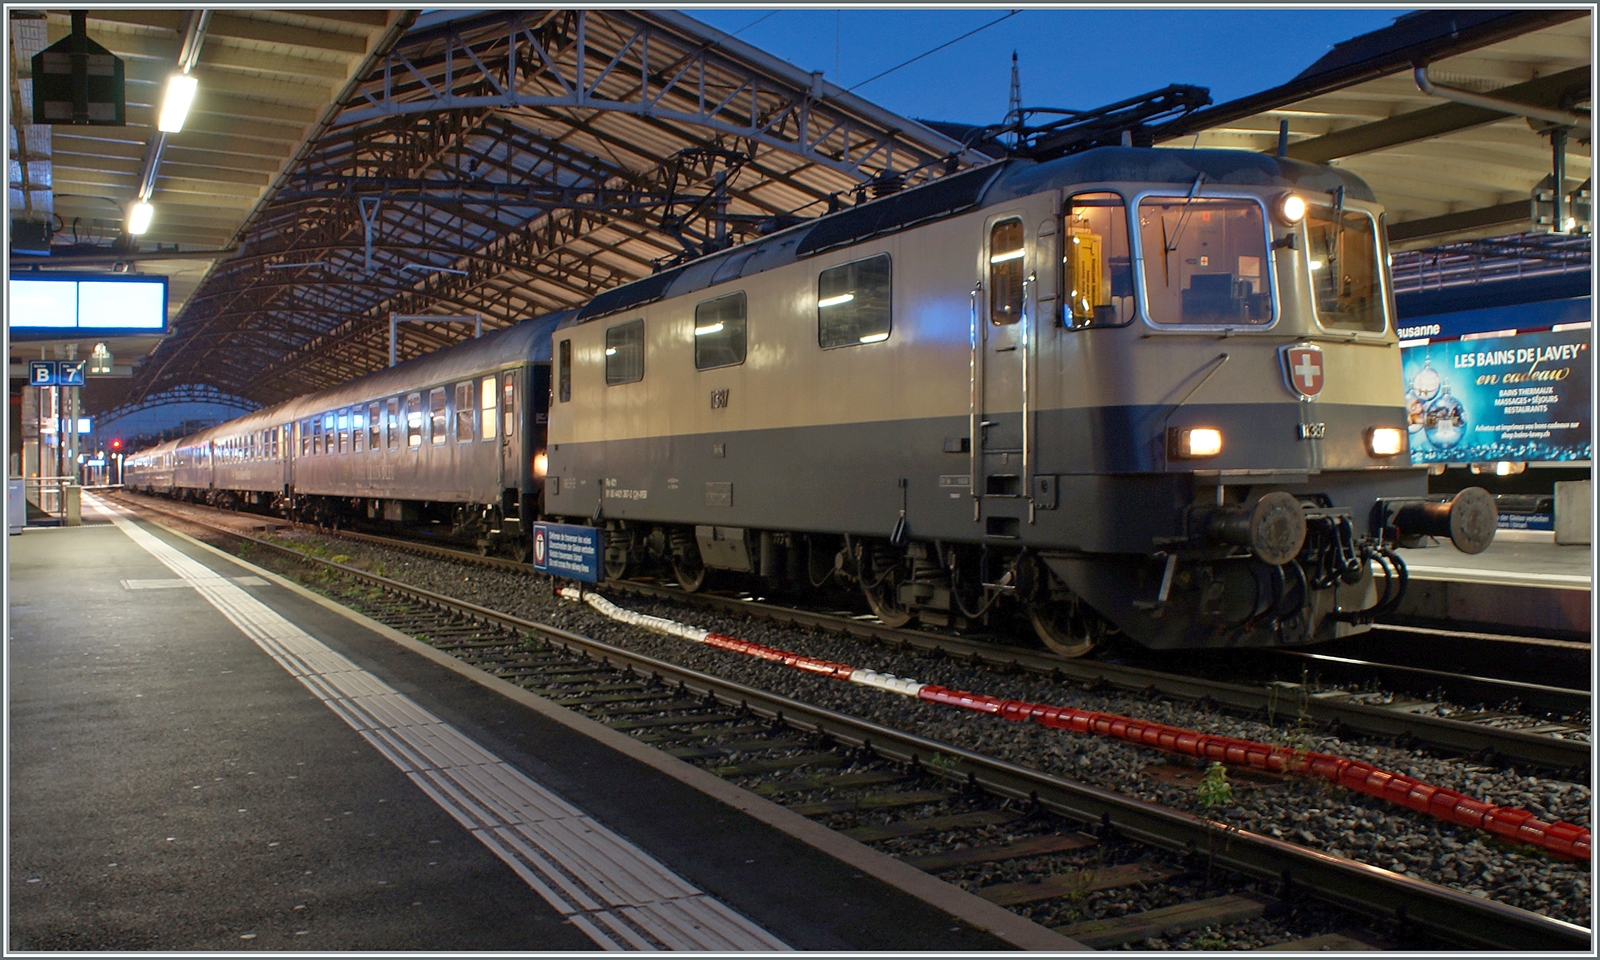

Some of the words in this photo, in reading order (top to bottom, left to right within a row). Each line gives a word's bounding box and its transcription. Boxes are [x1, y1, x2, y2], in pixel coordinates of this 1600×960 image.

[1397, 324, 1441, 339] ausanne
[1454, 353, 1476, 369] LES
[1476, 349, 1515, 367] BAINS
[1517, 347, 1535, 363] DE
[1537, 343, 1581, 362] LAVEY
[36, 368, 50, 382] B
[66, 368, 77, 382] 7
[1475, 373, 1500, 386] en
[1502, 357, 1571, 384] cadeau
[1499, 388, 1518, 397] BAINS
[1519, 386, 1554, 396] THERMAUX
[1494, 396, 1528, 406] MASSAGES
[1504, 404, 1549, 414] RESTAURANTS
